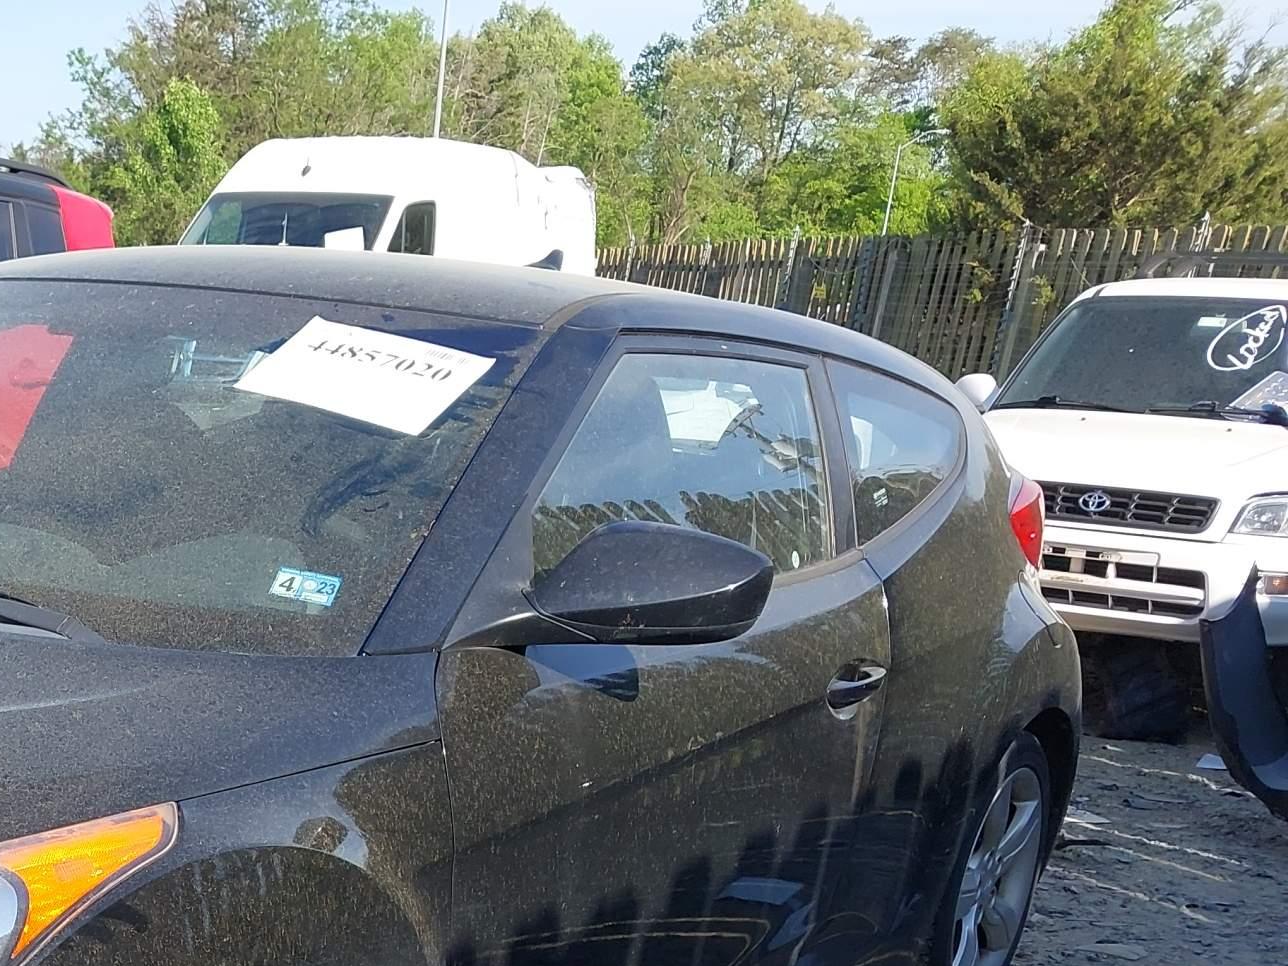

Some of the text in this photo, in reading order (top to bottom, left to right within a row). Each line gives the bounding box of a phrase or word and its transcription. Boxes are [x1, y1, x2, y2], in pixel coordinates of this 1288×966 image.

[308, 339, 453, 382] 44857020
[278, 576, 337, 596] 4 23
